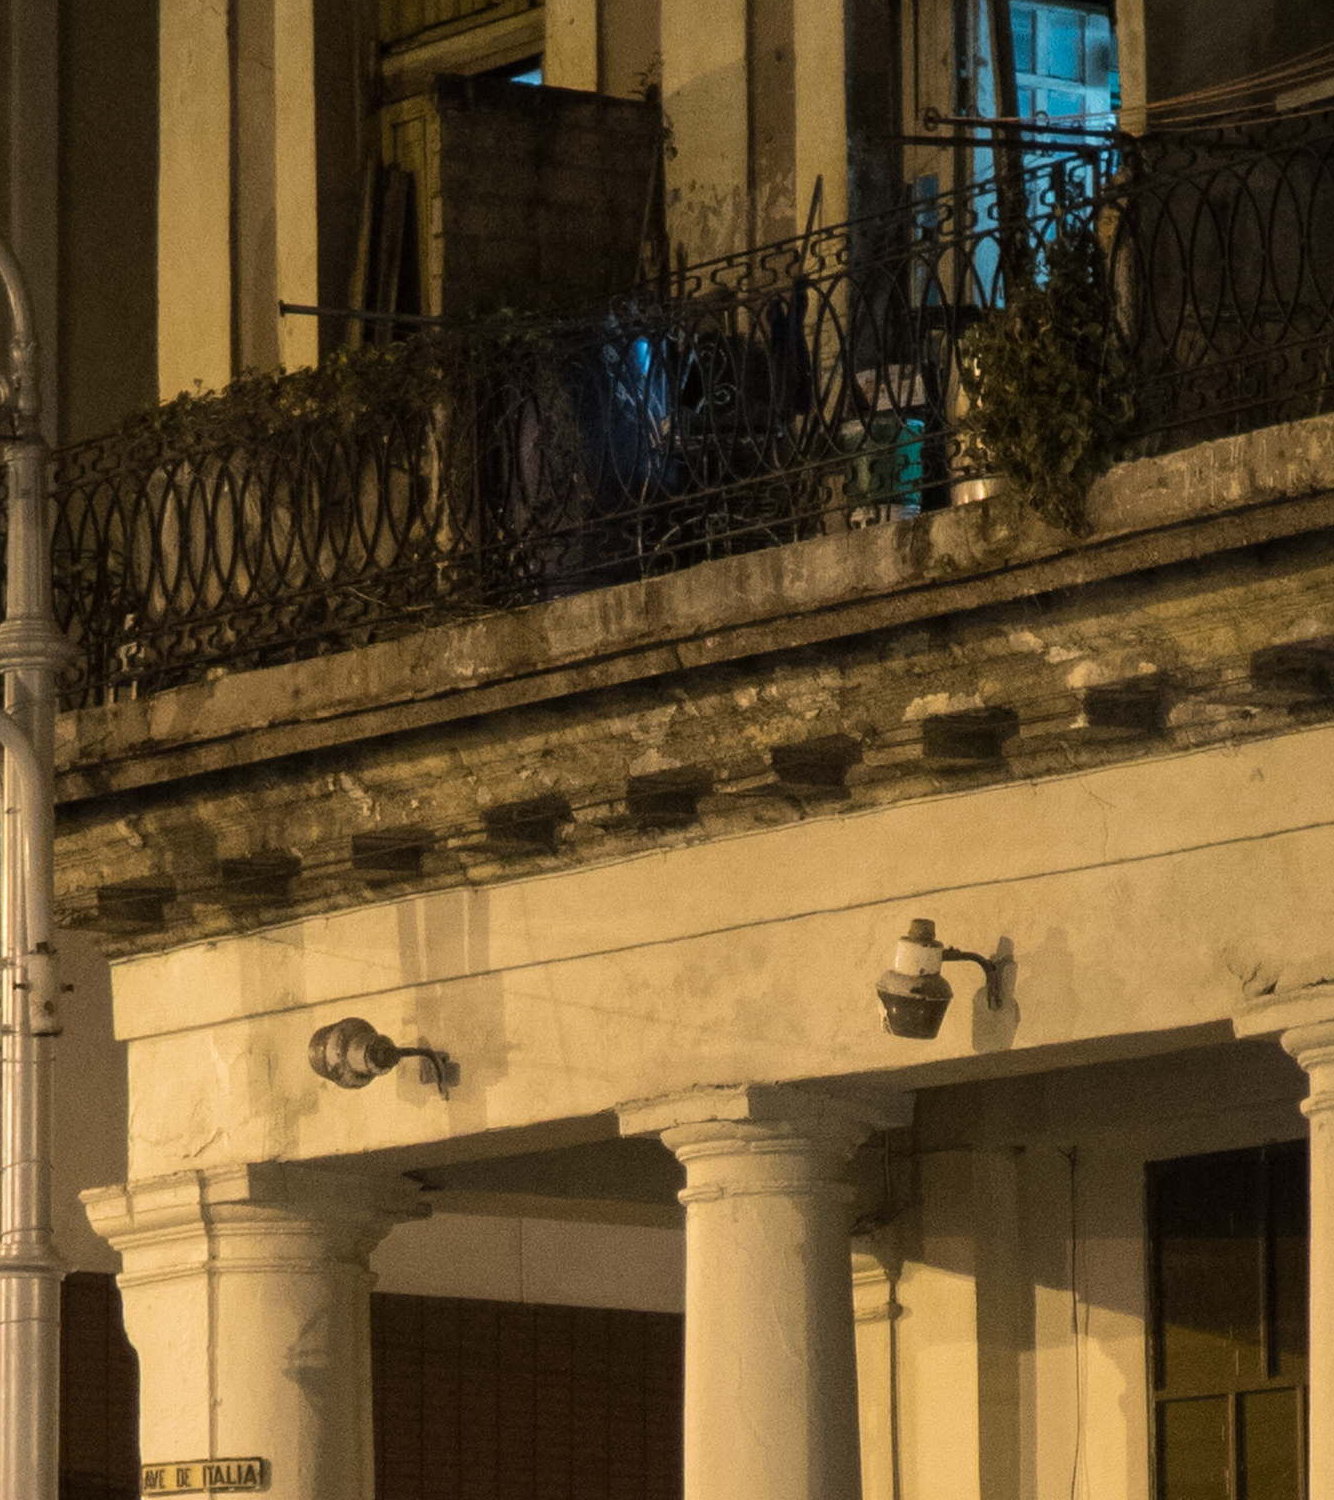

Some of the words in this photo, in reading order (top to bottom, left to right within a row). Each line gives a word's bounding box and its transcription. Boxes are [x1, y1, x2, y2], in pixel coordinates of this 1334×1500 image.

[143, 1469, 165, 1490] AVE
[176, 1467, 191, 1488] DE
[203, 1463, 258, 1486] ITALIA
